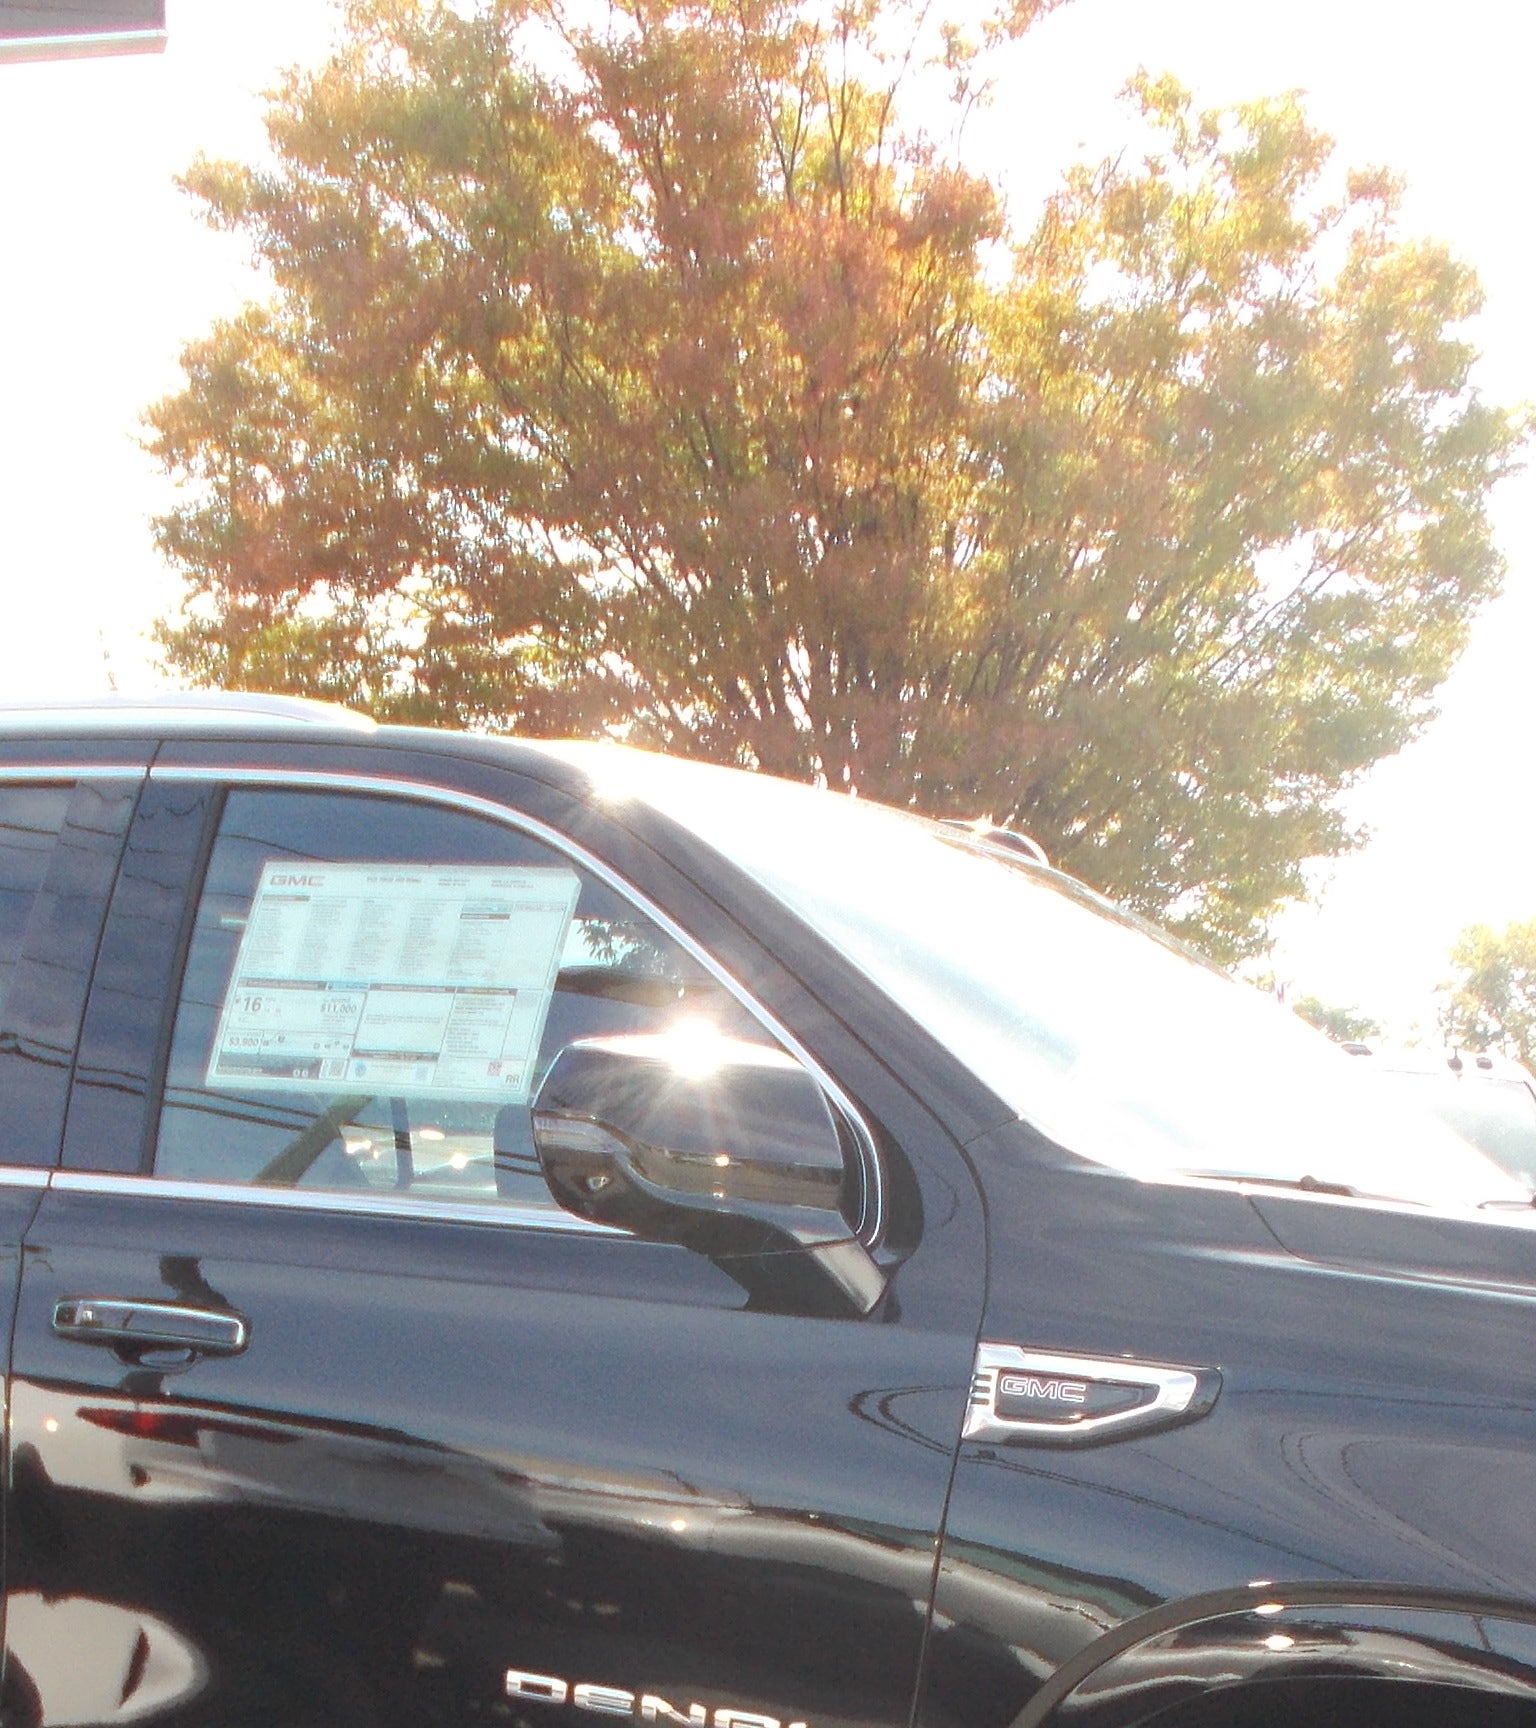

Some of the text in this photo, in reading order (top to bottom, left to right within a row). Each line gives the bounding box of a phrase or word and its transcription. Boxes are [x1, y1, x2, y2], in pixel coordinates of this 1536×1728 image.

[270, 875, 325, 886] GMC
[244, 996, 263, 1013] 16
[320, 1003, 357, 1014] $11,000
[1000, 1376, 1087, 1403] GMC
